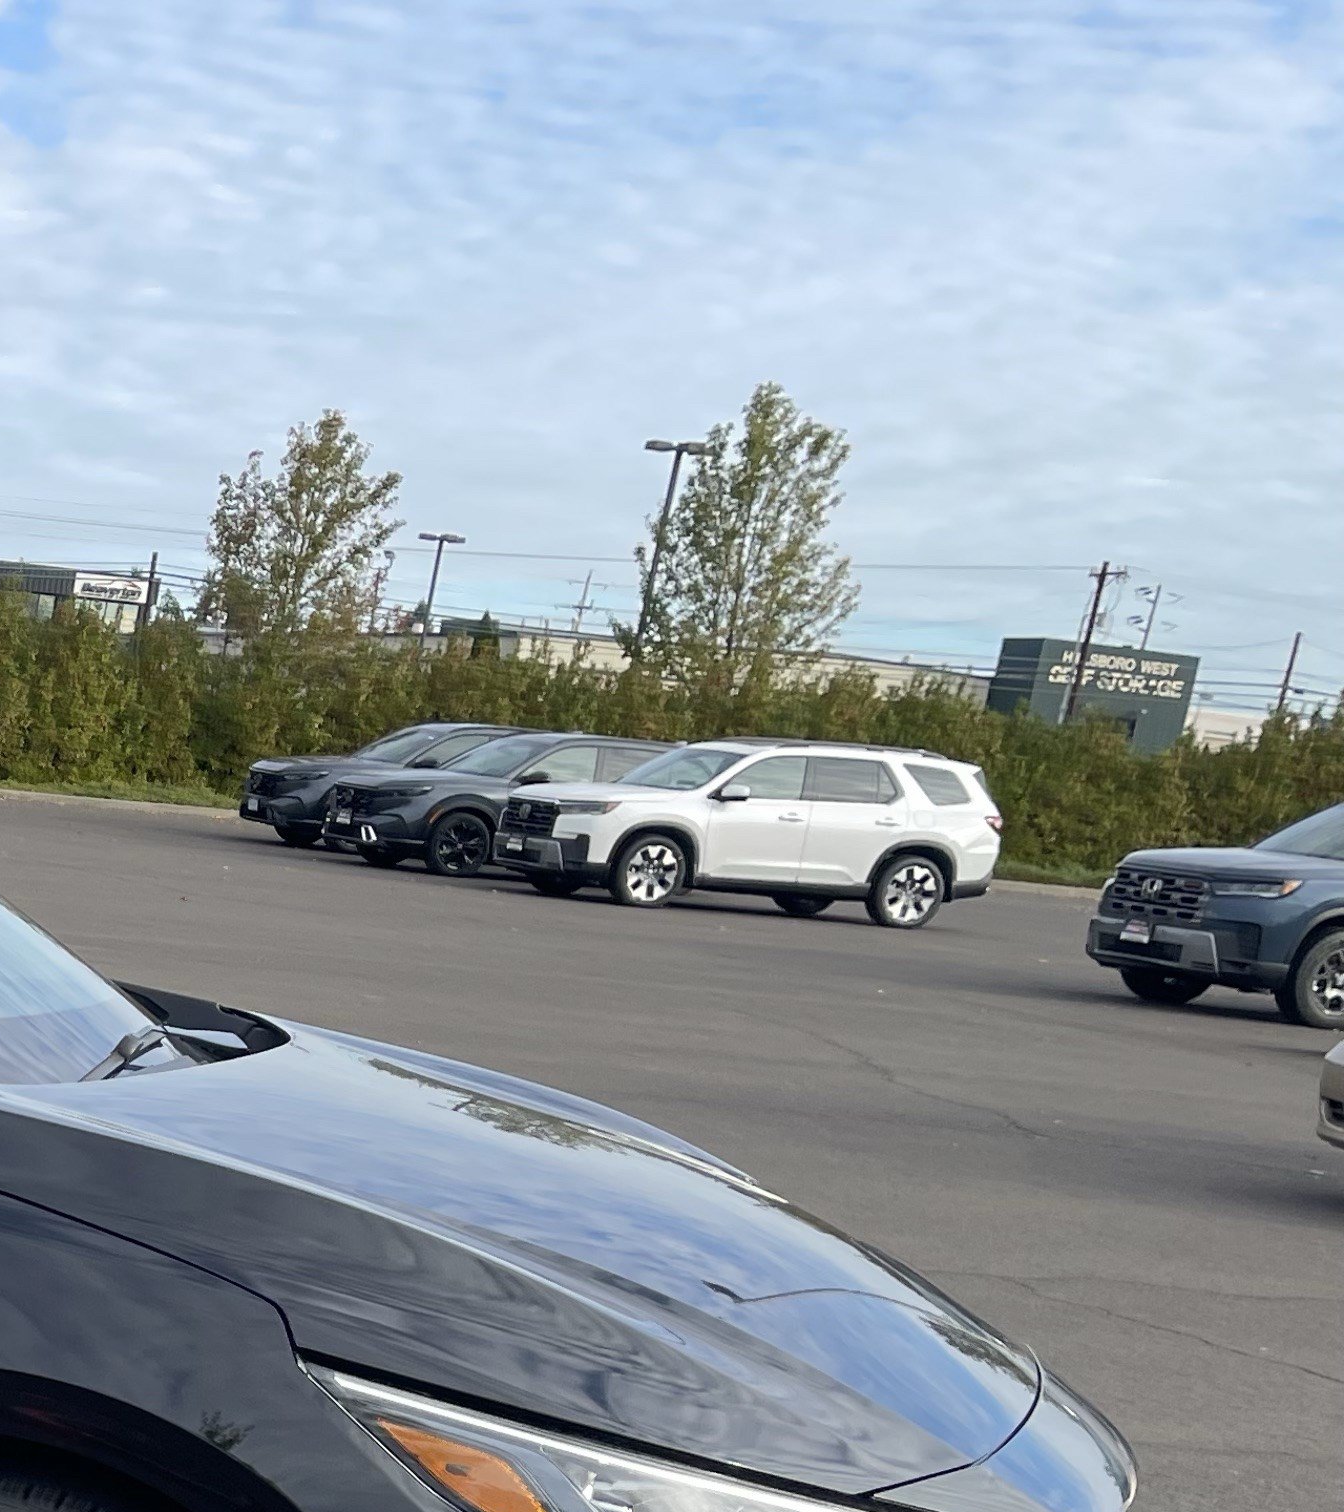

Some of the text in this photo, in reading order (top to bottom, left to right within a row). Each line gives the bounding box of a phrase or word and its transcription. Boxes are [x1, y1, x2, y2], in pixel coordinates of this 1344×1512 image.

[1061, 649, 1180, 677] HILSBORO WEST
[1047, 666, 1096, 686] SEF
